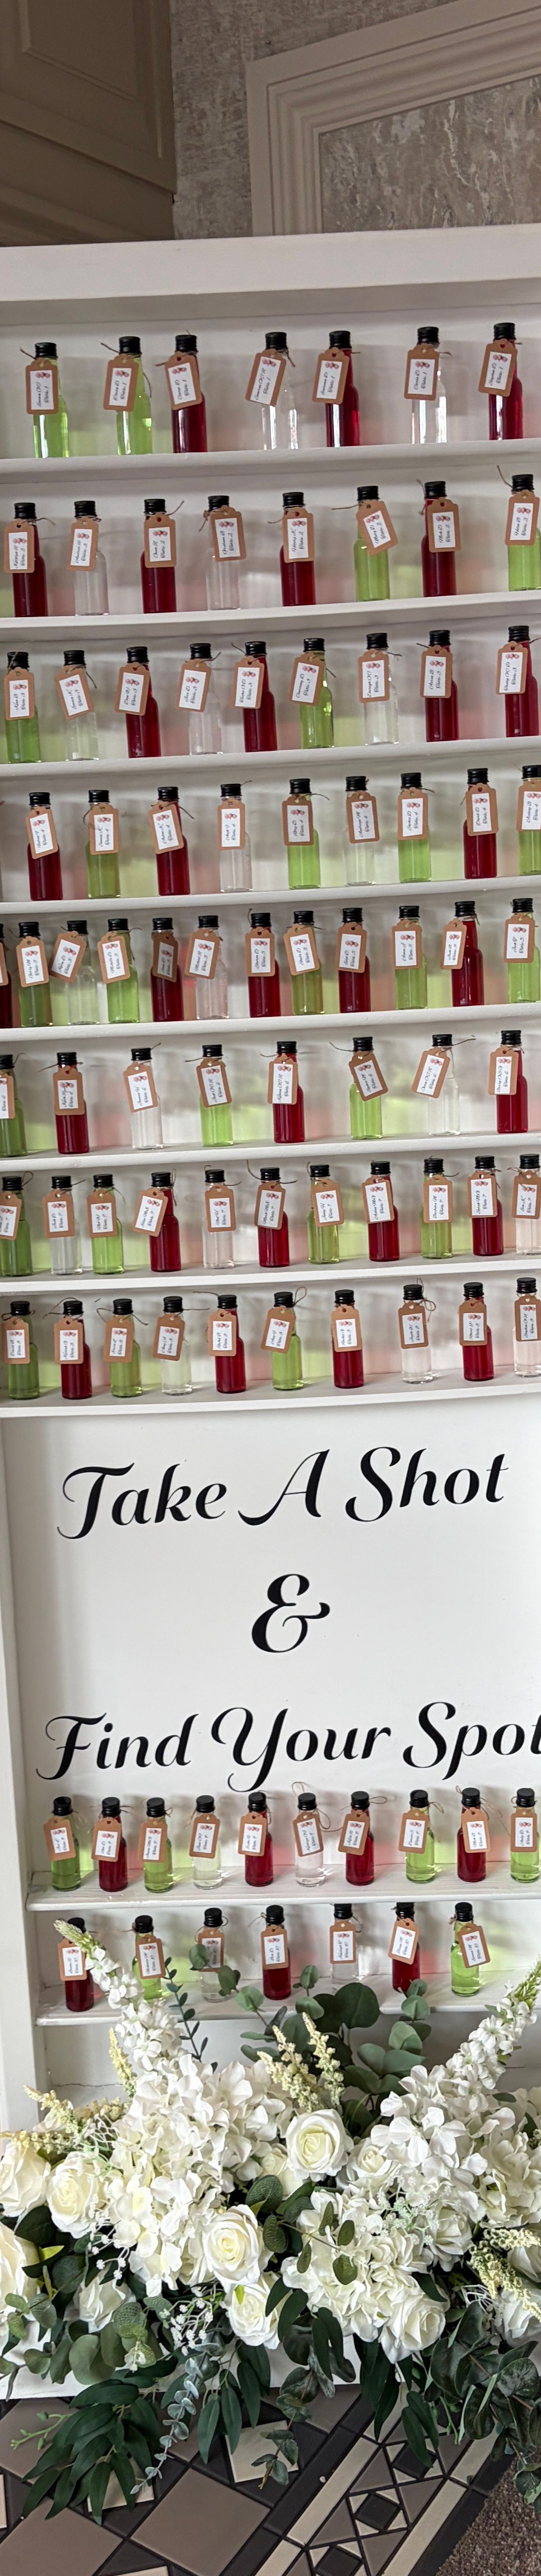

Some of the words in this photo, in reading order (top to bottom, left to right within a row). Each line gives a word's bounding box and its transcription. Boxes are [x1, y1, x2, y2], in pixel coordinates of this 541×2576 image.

[57, 1463, 226, 1539] Take
[238, 1449, 330, 1525] A
[346, 1447, 509, 1522] Shot
[252, 1574, 330, 1652] &
[36, 1713, 198, 1780] Find
[211, 1708, 391, 1792] Your
[403, 1702, 541, 1780] Spot
